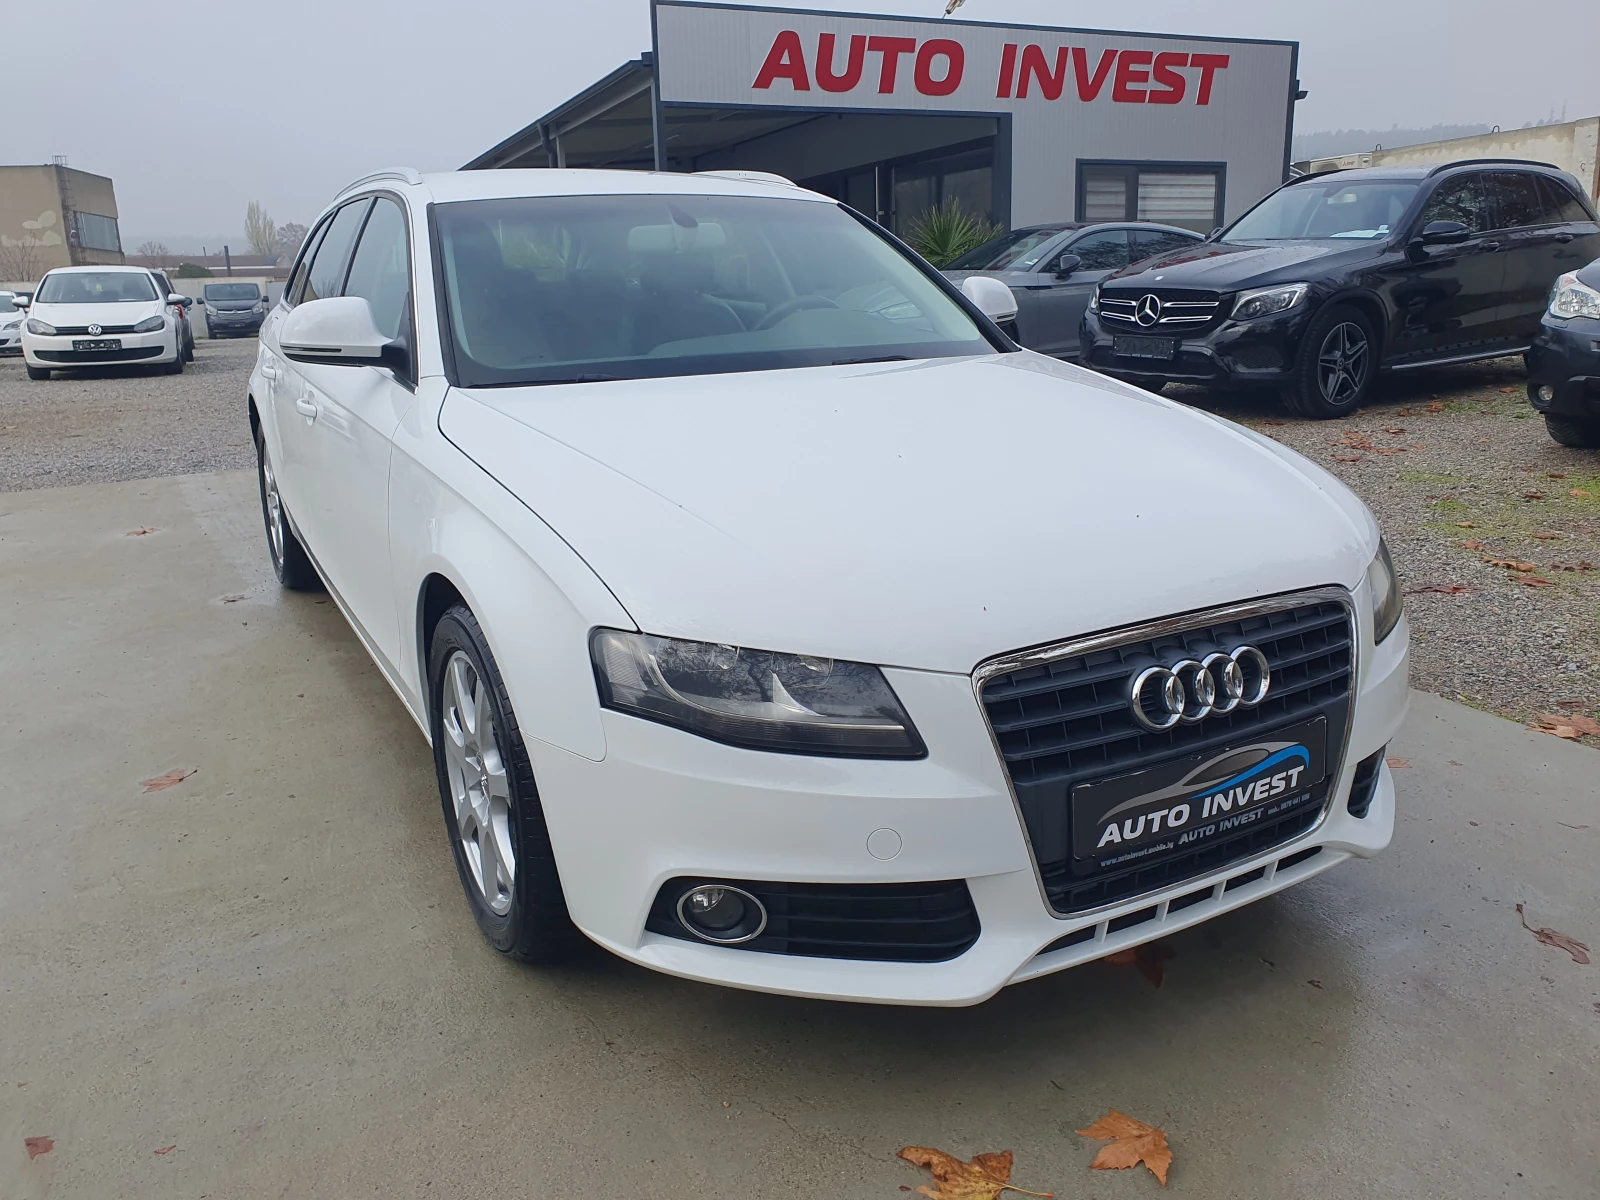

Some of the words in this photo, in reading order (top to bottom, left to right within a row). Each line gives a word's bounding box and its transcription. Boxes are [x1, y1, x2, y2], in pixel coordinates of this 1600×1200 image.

[752, 30, 965, 97] AUTO
[996, 43, 1230, 105] INVEST
[1097, 803, 1190, 848] AUTO
[1201, 765, 1305, 818] INVEST
[1178, 825, 1215, 845] AUTO
[1219, 808, 1264, 832] INVEST
